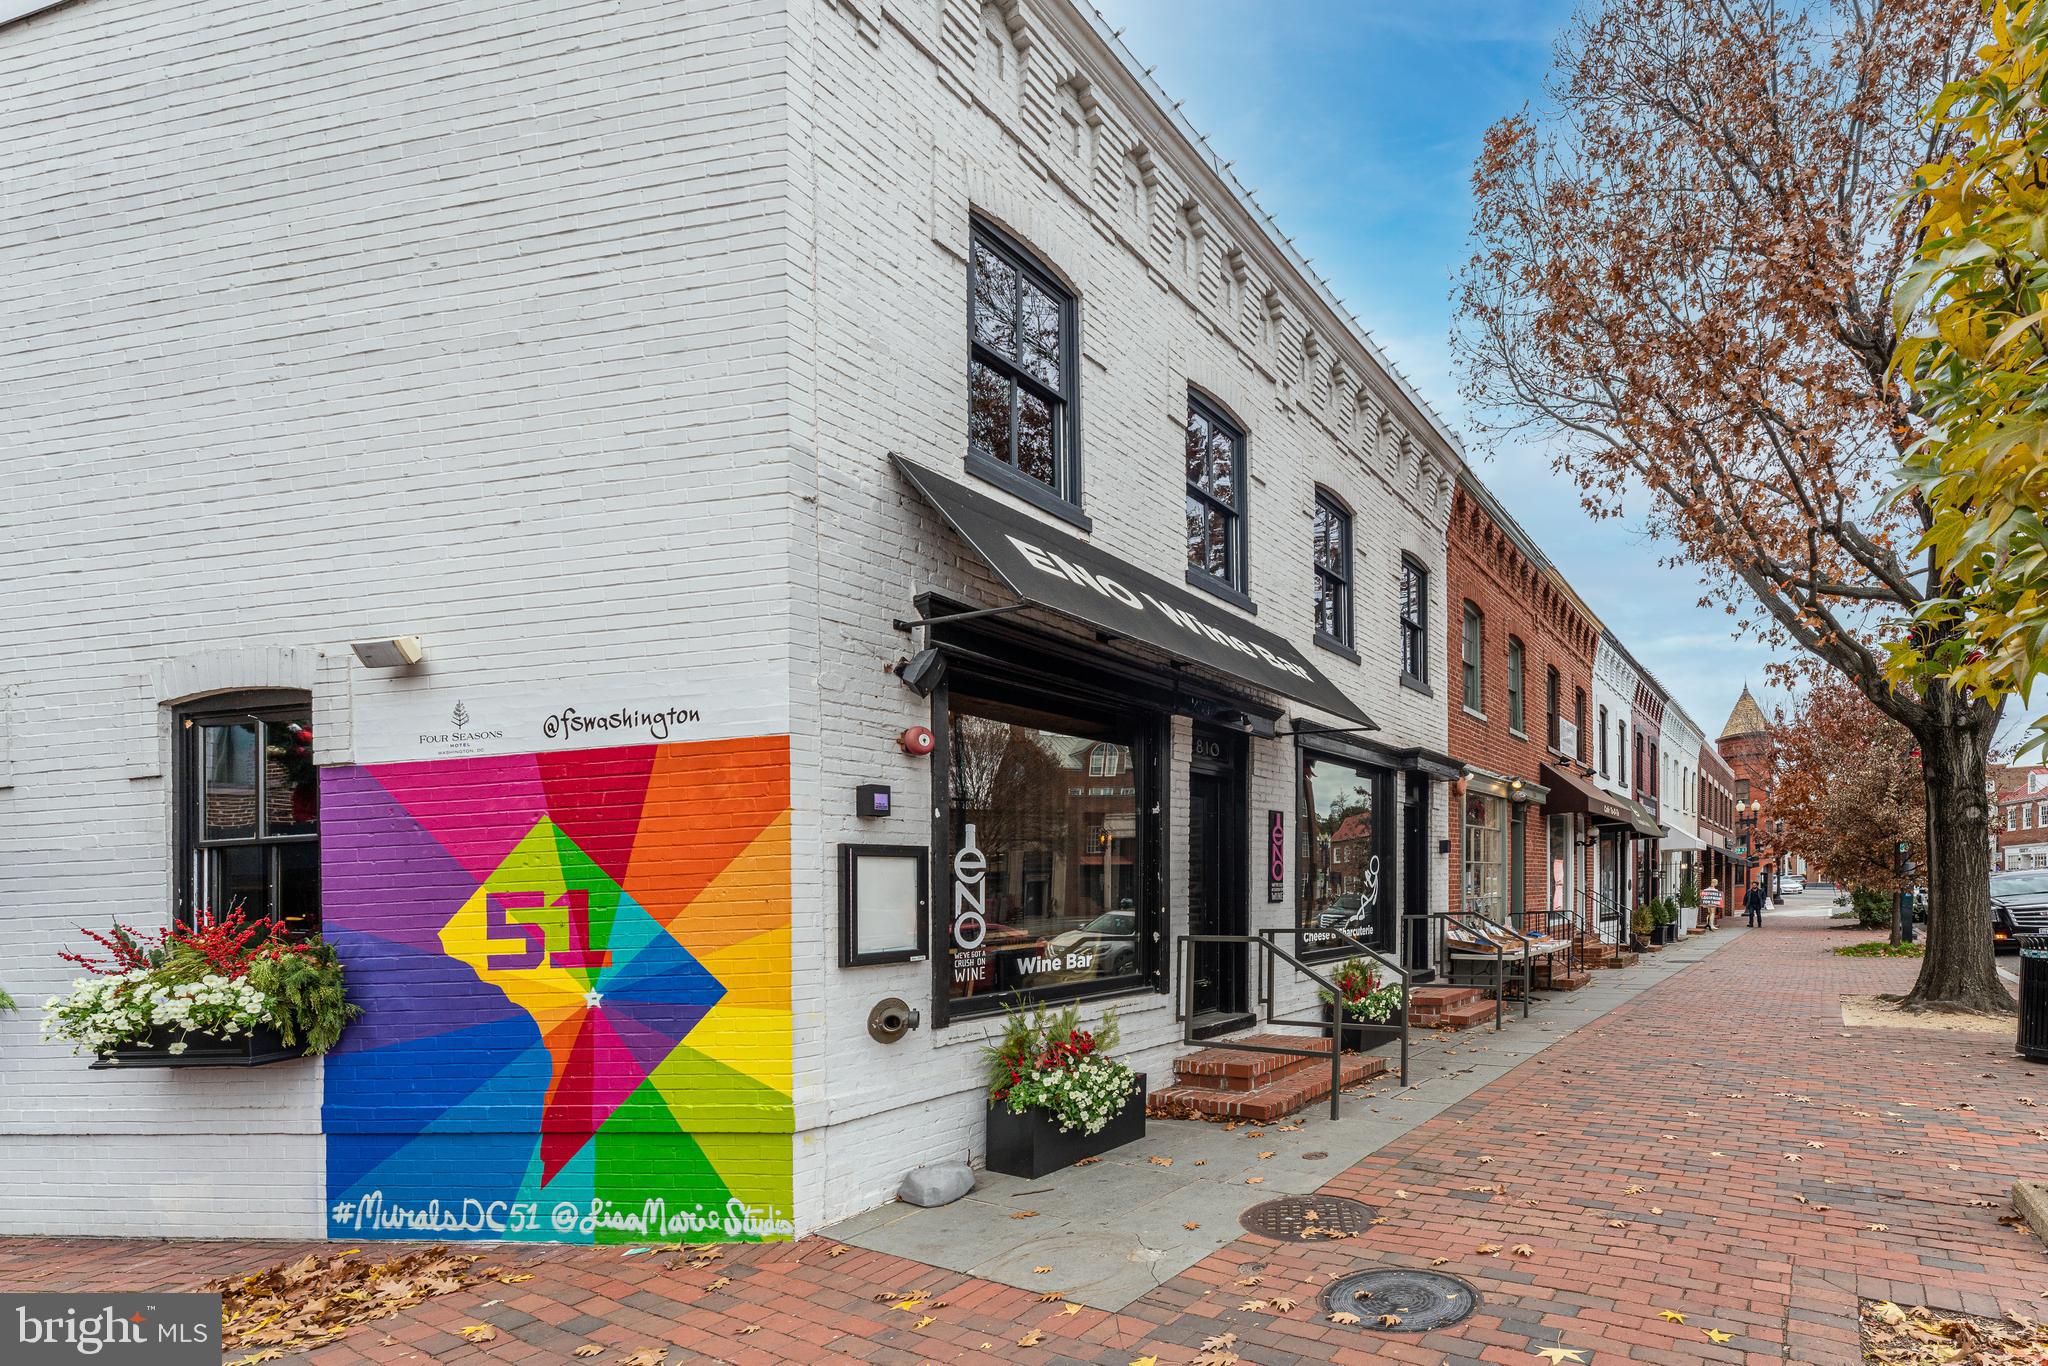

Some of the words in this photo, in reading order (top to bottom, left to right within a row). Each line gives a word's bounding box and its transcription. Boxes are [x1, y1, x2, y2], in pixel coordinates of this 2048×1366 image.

[1005, 534, 1144, 610] ENO
[1140, 592, 1258, 659] Wine
[1248, 641, 1315, 683] Bar
[543, 707, 700, 740] @fswashington
[419, 734, 448, 744] FOUR
[452, 731, 503, 741] SEASONS
[1196, 739, 1220, 757] 810
[486, 890, 612, 970] 51
[1303, 932, 1330, 943] Cheese
[954, 951, 970, 959] WE'VE
[954, 959, 975, 968] CRUSH
[977, 958, 986, 966] ON
[1017, 955, 1062, 975] Wine
[1066, 953, 1093, 969] Bar
[954, 966, 986, 983] WINE
[332, 1190, 541, 1232] #MuralsDC51
